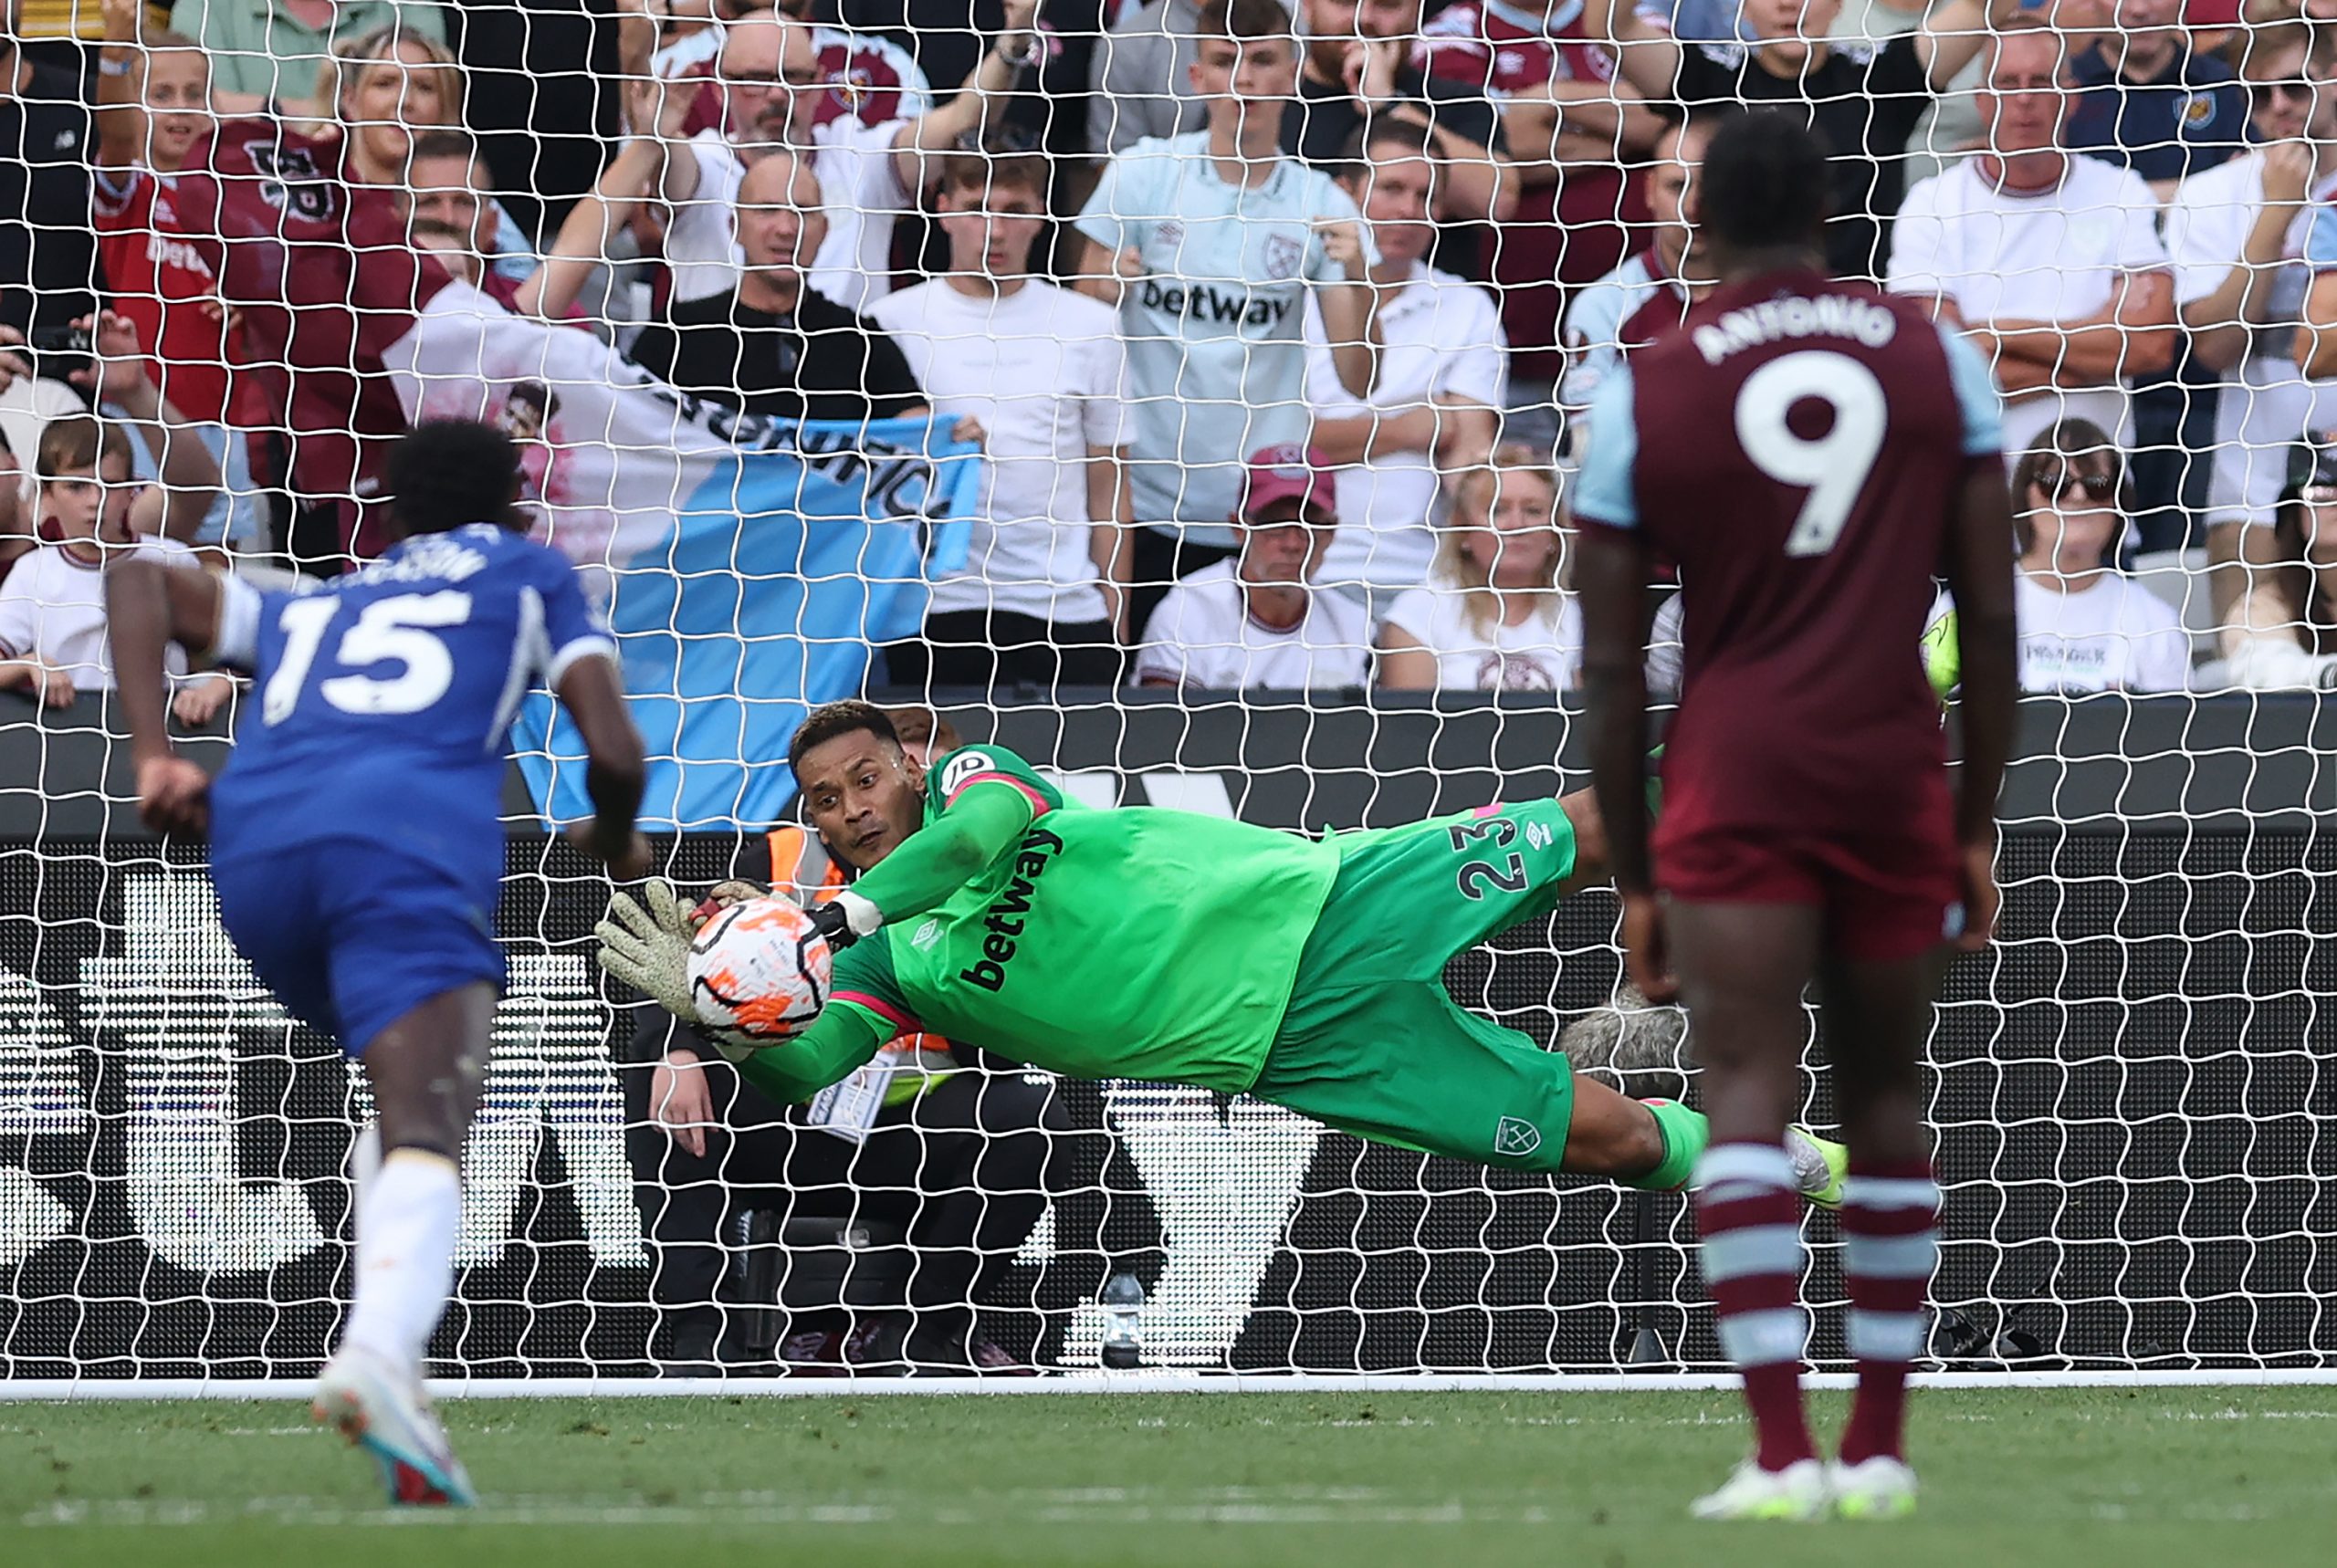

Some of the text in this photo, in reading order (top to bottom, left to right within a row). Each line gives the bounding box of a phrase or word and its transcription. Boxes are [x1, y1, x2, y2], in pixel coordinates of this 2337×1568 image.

[1143, 267, 1293, 325] betway
[1692, 294, 1897, 366] ANTONIO
[1734, 349, 1889, 559] 9
[262, 589, 474, 727] 15
[959, 828, 1064, 993] betway
[1447, 818, 1529, 902] 23
